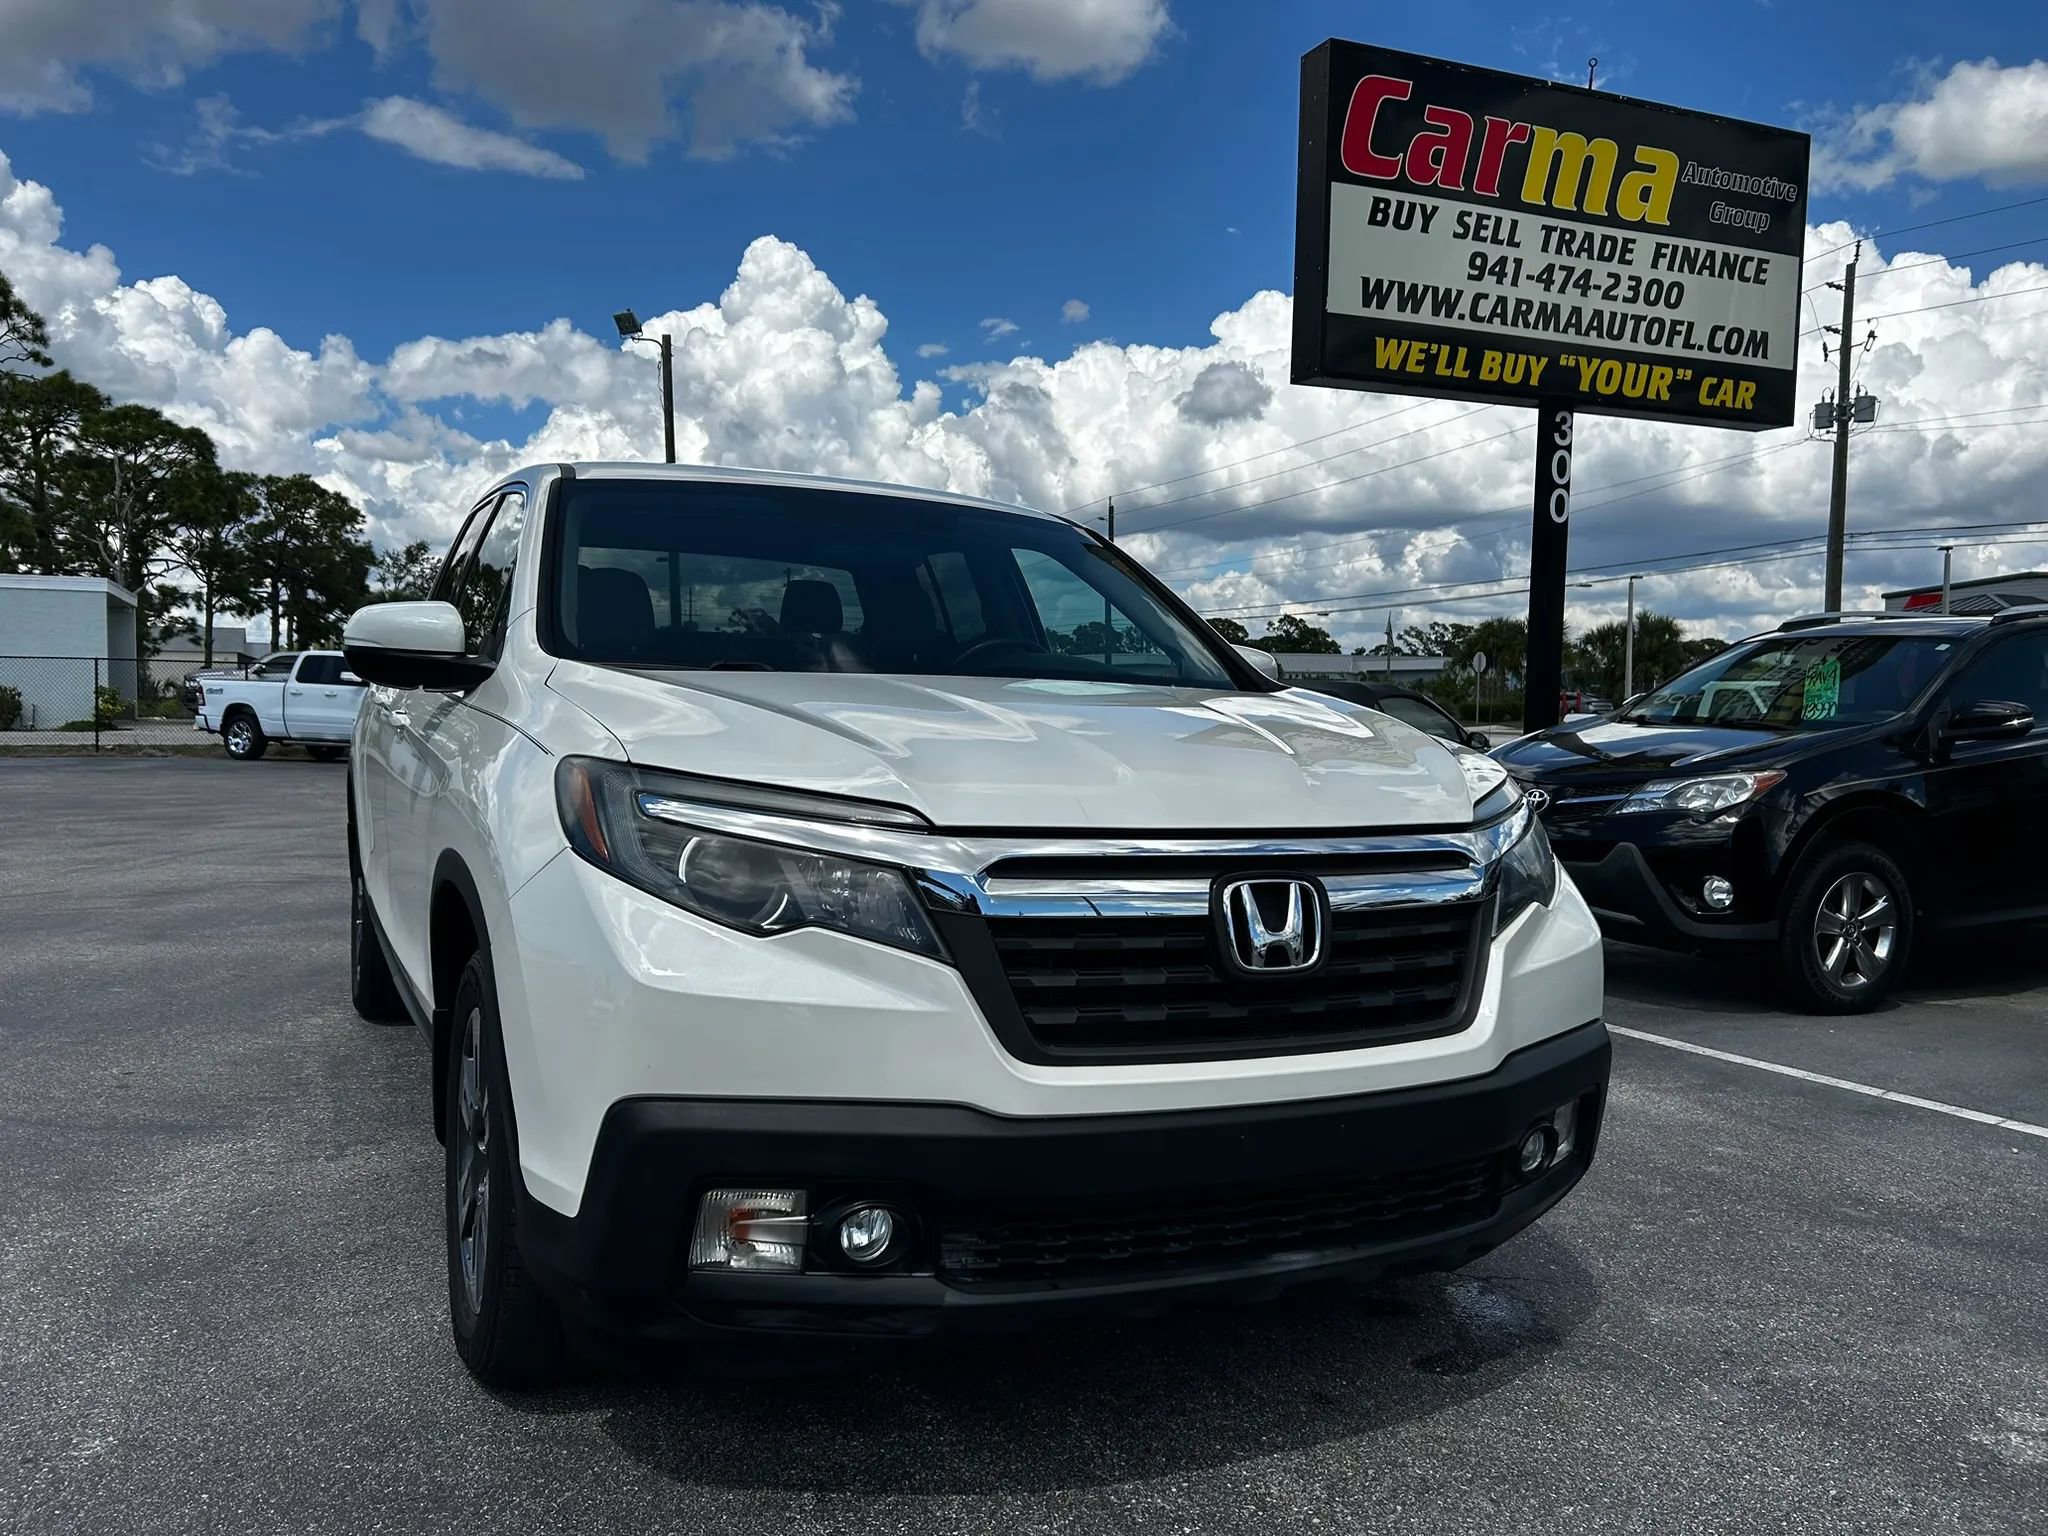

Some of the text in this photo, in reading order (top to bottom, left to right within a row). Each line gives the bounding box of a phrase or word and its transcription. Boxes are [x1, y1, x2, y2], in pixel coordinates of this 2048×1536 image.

[1341, 74, 1680, 226] Carma
[1681, 161, 1798, 201] Automotive
[1367, 196, 1770, 285] BUY SELL TRADE FINANCE
[1709, 201, 1771, 233] Group
[1360, 276, 1769, 359] WWW.CARMAAUTOFL.COM
[1467, 251, 1685, 309] 941-474-2300
[1375, 336, 1757, 410] WE'LL BUY "YOUR" CAR
[1550, 411, 1572, 523] 300
